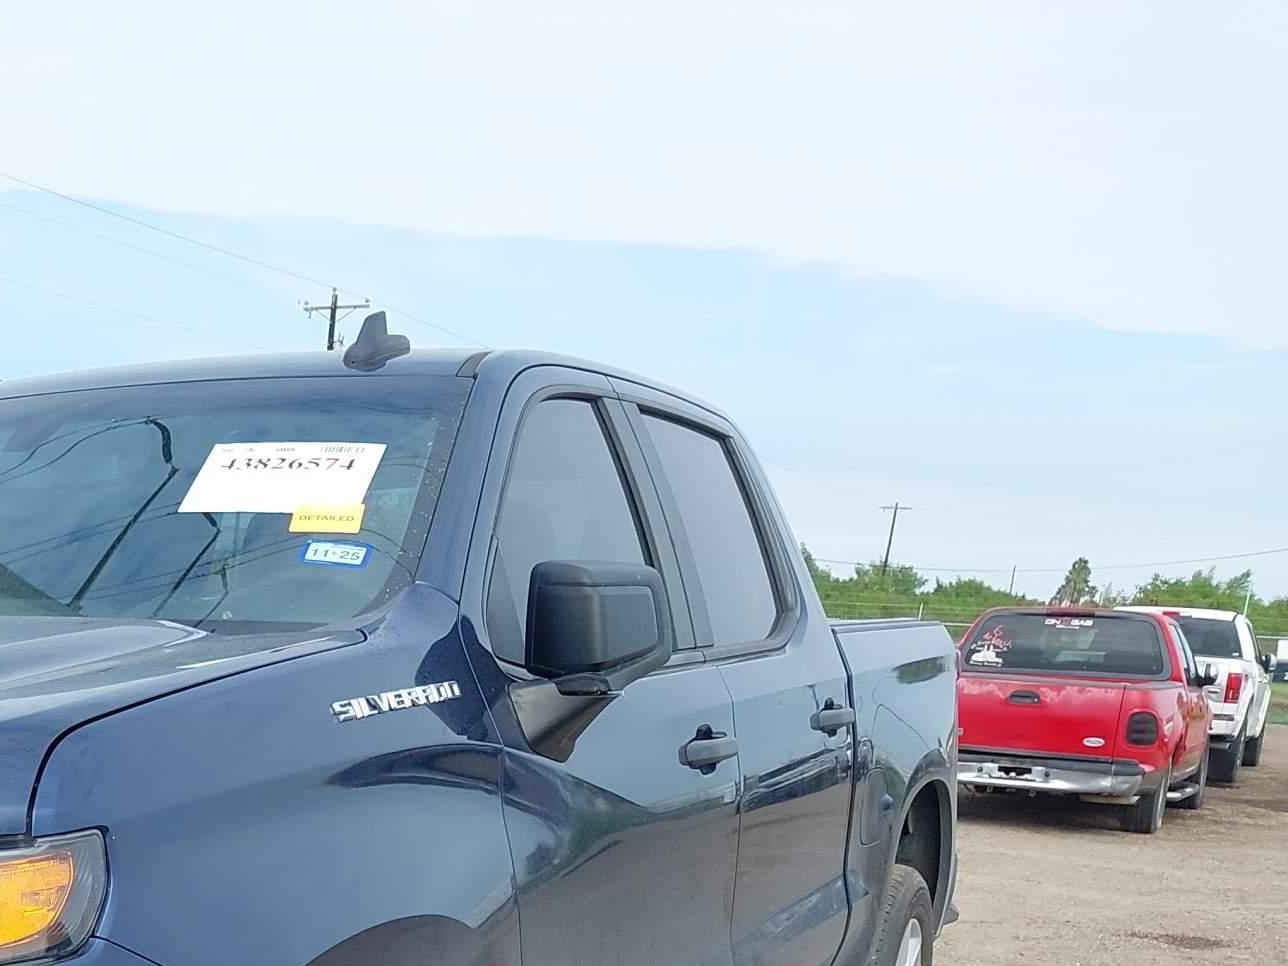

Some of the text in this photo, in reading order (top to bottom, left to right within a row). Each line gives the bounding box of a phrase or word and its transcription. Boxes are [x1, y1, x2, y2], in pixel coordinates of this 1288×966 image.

[220, 456, 357, 471] 43826574
[298, 514, 355, 523] DETAILED
[329, 679, 462, 723] SILVERADO
